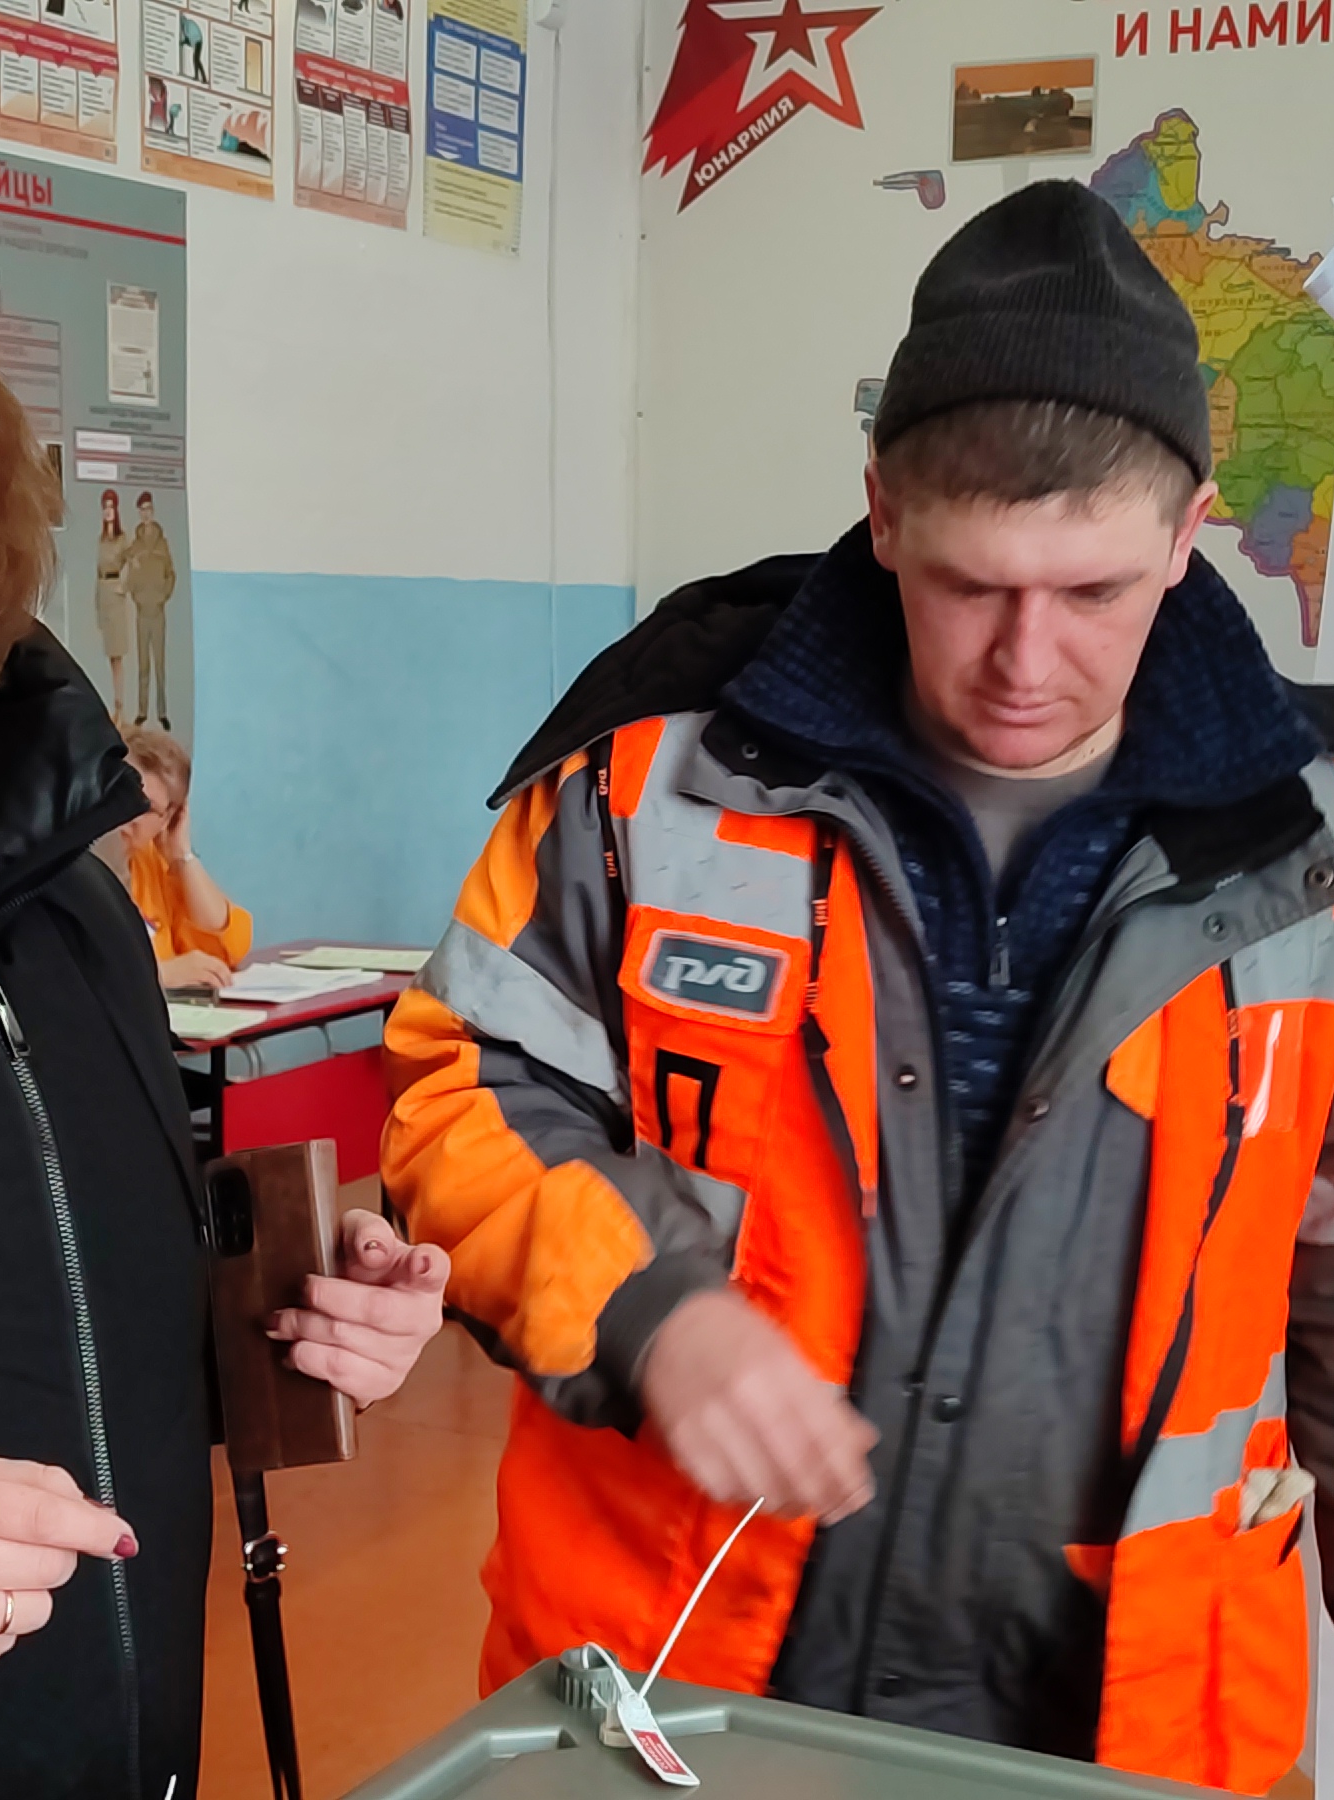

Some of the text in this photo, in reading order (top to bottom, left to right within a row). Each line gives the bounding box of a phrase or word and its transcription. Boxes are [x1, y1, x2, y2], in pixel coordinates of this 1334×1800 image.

[1115, 12, 1148, 58] И
[1168, 0, 1331, 54] НАМИ
[693, 95, 795, 187] ЮНАРМИЯ
